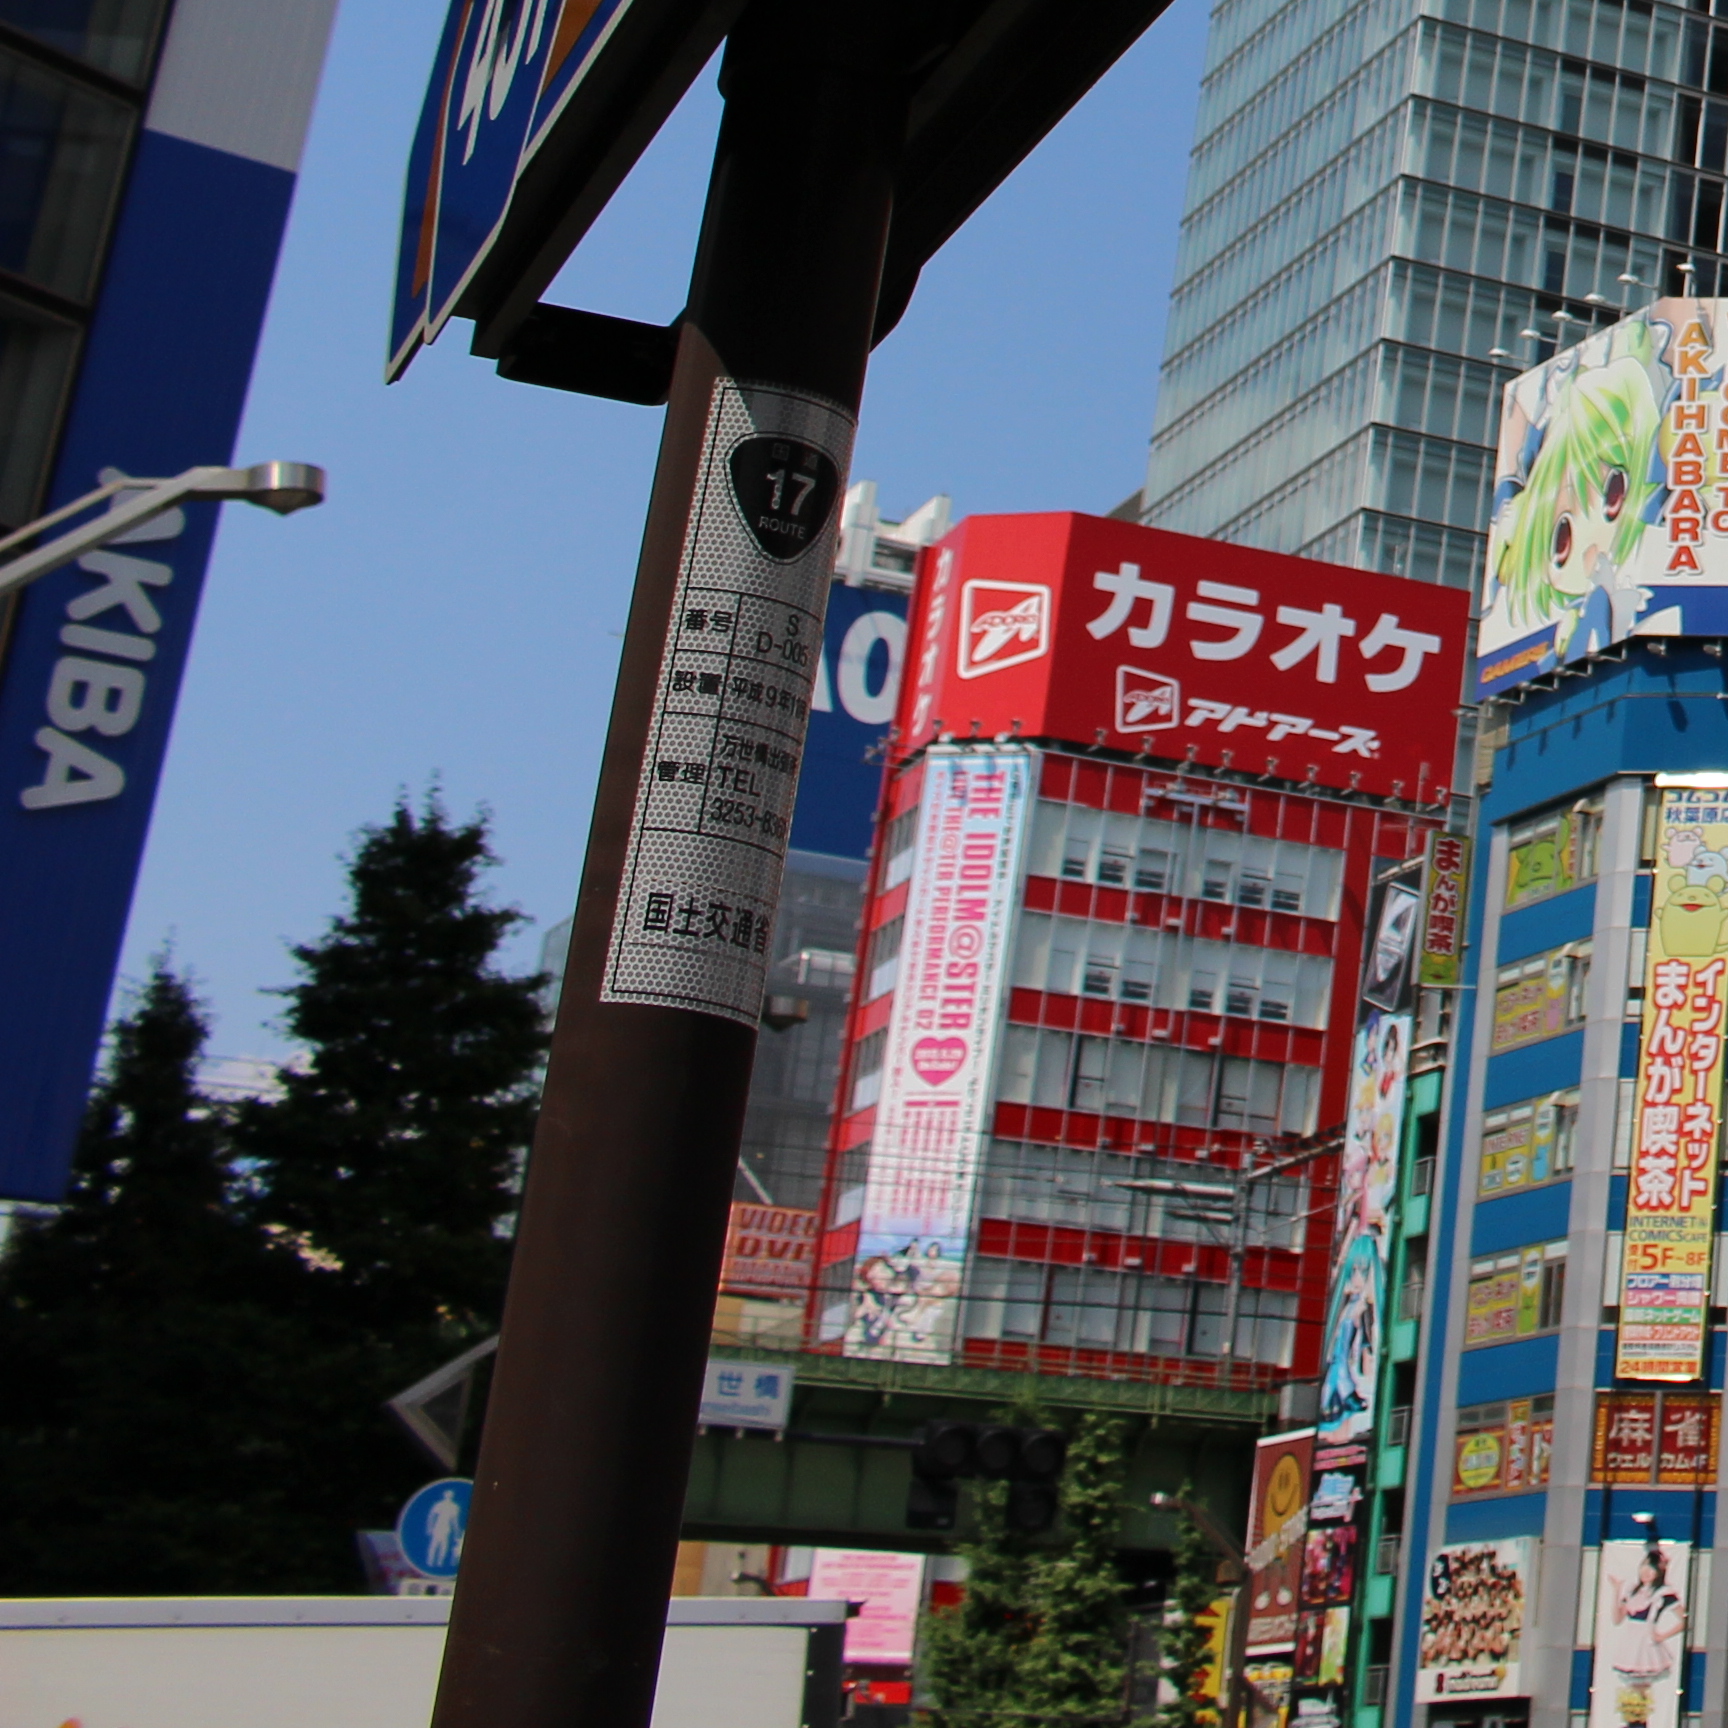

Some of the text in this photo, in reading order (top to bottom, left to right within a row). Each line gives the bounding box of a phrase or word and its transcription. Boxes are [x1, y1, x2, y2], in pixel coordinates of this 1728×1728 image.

[1667, 315, 1712, 575] AKIHABARA
[766, 469, 816, 516] 17
[758, 515, 807, 539] ROUTE
[684, 609, 733, 635] 番号
[911, 547, 954, 736] カラオケ
[1086, 561, 1441, 693] カラオケ
[1184, 697, 1380, 759] アドアーズ
[657, 759, 706, 785] 管理
[717, 765, 760, 798] TEL
[967, 770, 1006, 820] THE
[644, 892, 772, 956] 国土交通省
[1426, 837, 1463, 955] まんが喫茶
[938, 830, 998, 1032] IDOLM@STER
[1634, 958, 1689, 1211] まんが喫茶
[1679, 957, 1727, 1212] インターネット
[1608, 1409, 1707, 1449] 麻雀
